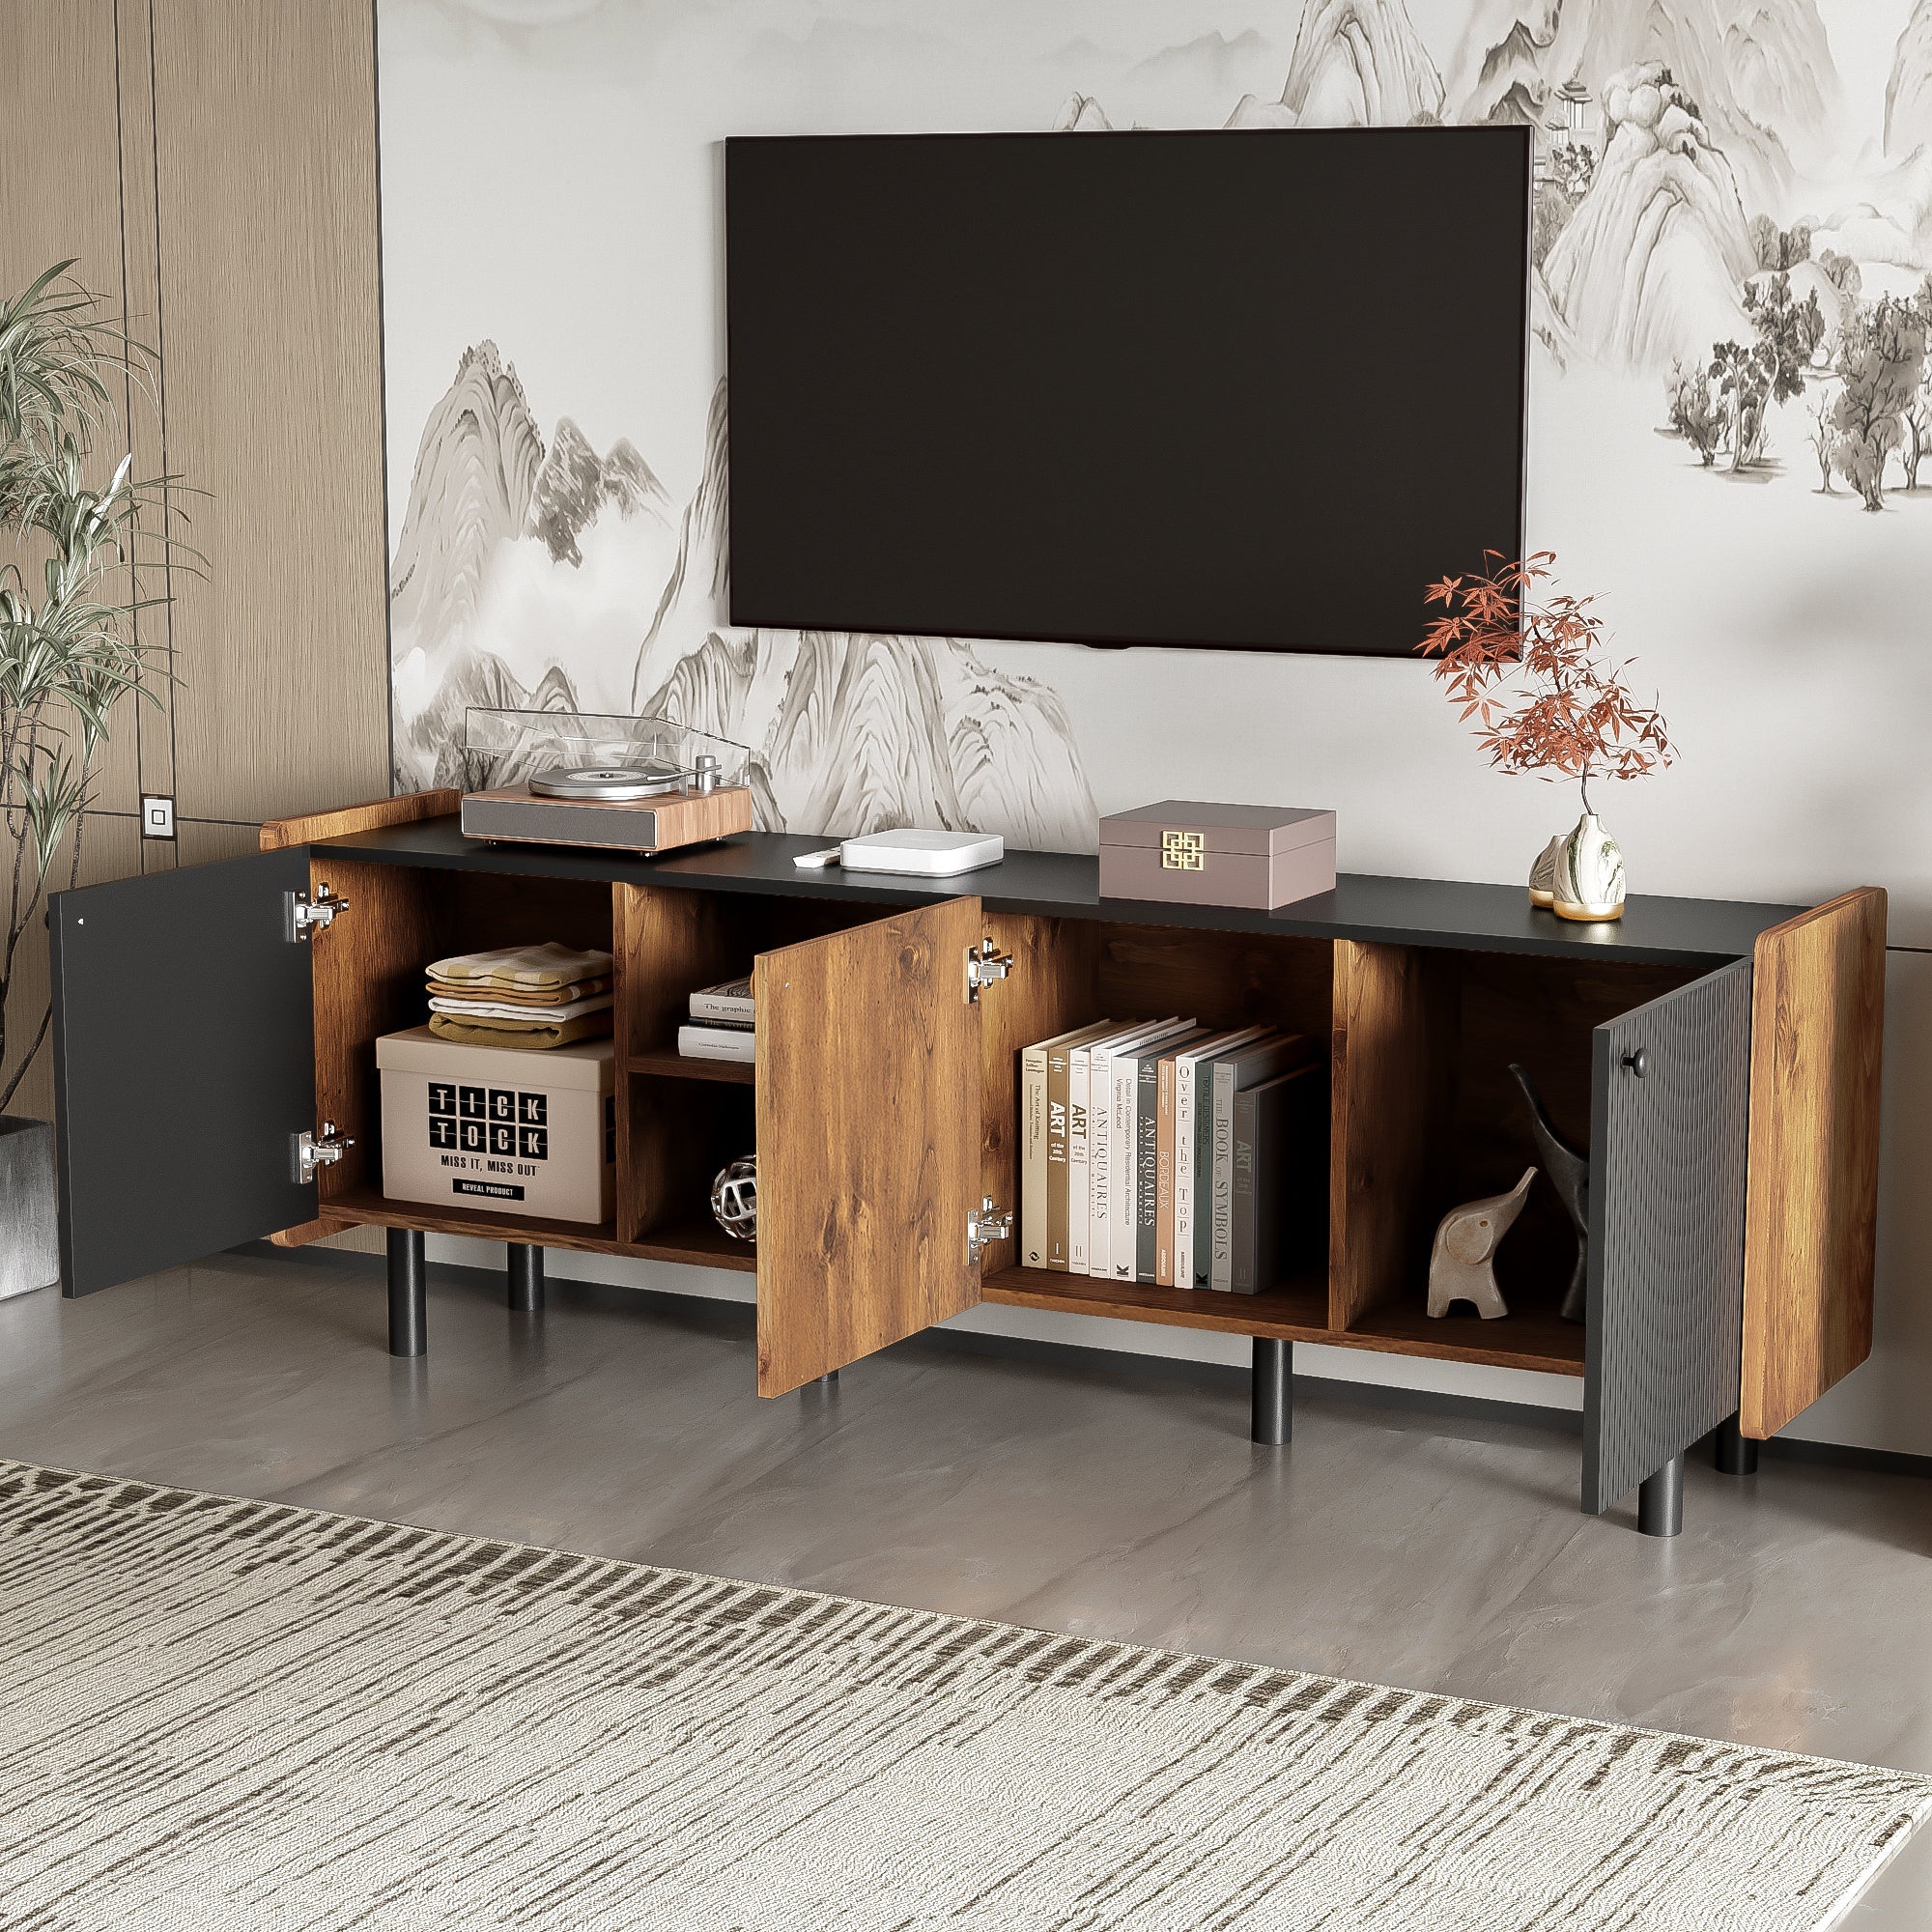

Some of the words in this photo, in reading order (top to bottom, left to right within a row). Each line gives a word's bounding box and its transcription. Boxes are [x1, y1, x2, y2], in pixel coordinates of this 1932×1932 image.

[722, 1006, 752, 1014] graphic
[437, 1089, 539, 1121] TICK
[1115, 1078, 1123, 1102] Virginia
[1179, 1065, 1190, 1119] Over
[1202, 1075, 1210, 1103] TEXTILE
[1033, 1115, 1041, 1140] Knitting
[1050, 1100, 1065, 1138] ART
[1071, 1103, 1087, 1140] ART
[1202, 1105, 1210, 1145] DESIGNERS
[438, 1122, 540, 1154] TOCK
[1216, 1118, 1229, 1162] BOOK
[440, 1154, 467, 1169] MISS
[470, 1157, 483, 1173] IT,
[487, 1160, 514, 1175] MISS
[1095, 1107, 1108, 1219] ANTIQUAIRES
[1144, 1116, 1156, 1227] ANTIQUAIRES
[1236, 1139, 1253, 1173] ART
[462, 1182, 485, 1193] REVEAL
[486, 1185, 514, 1197] PRODUCT
[1159, 1151, 1170, 1209] BORDEAUX
[1215, 1180, 1229, 1260] SYMBOLS
